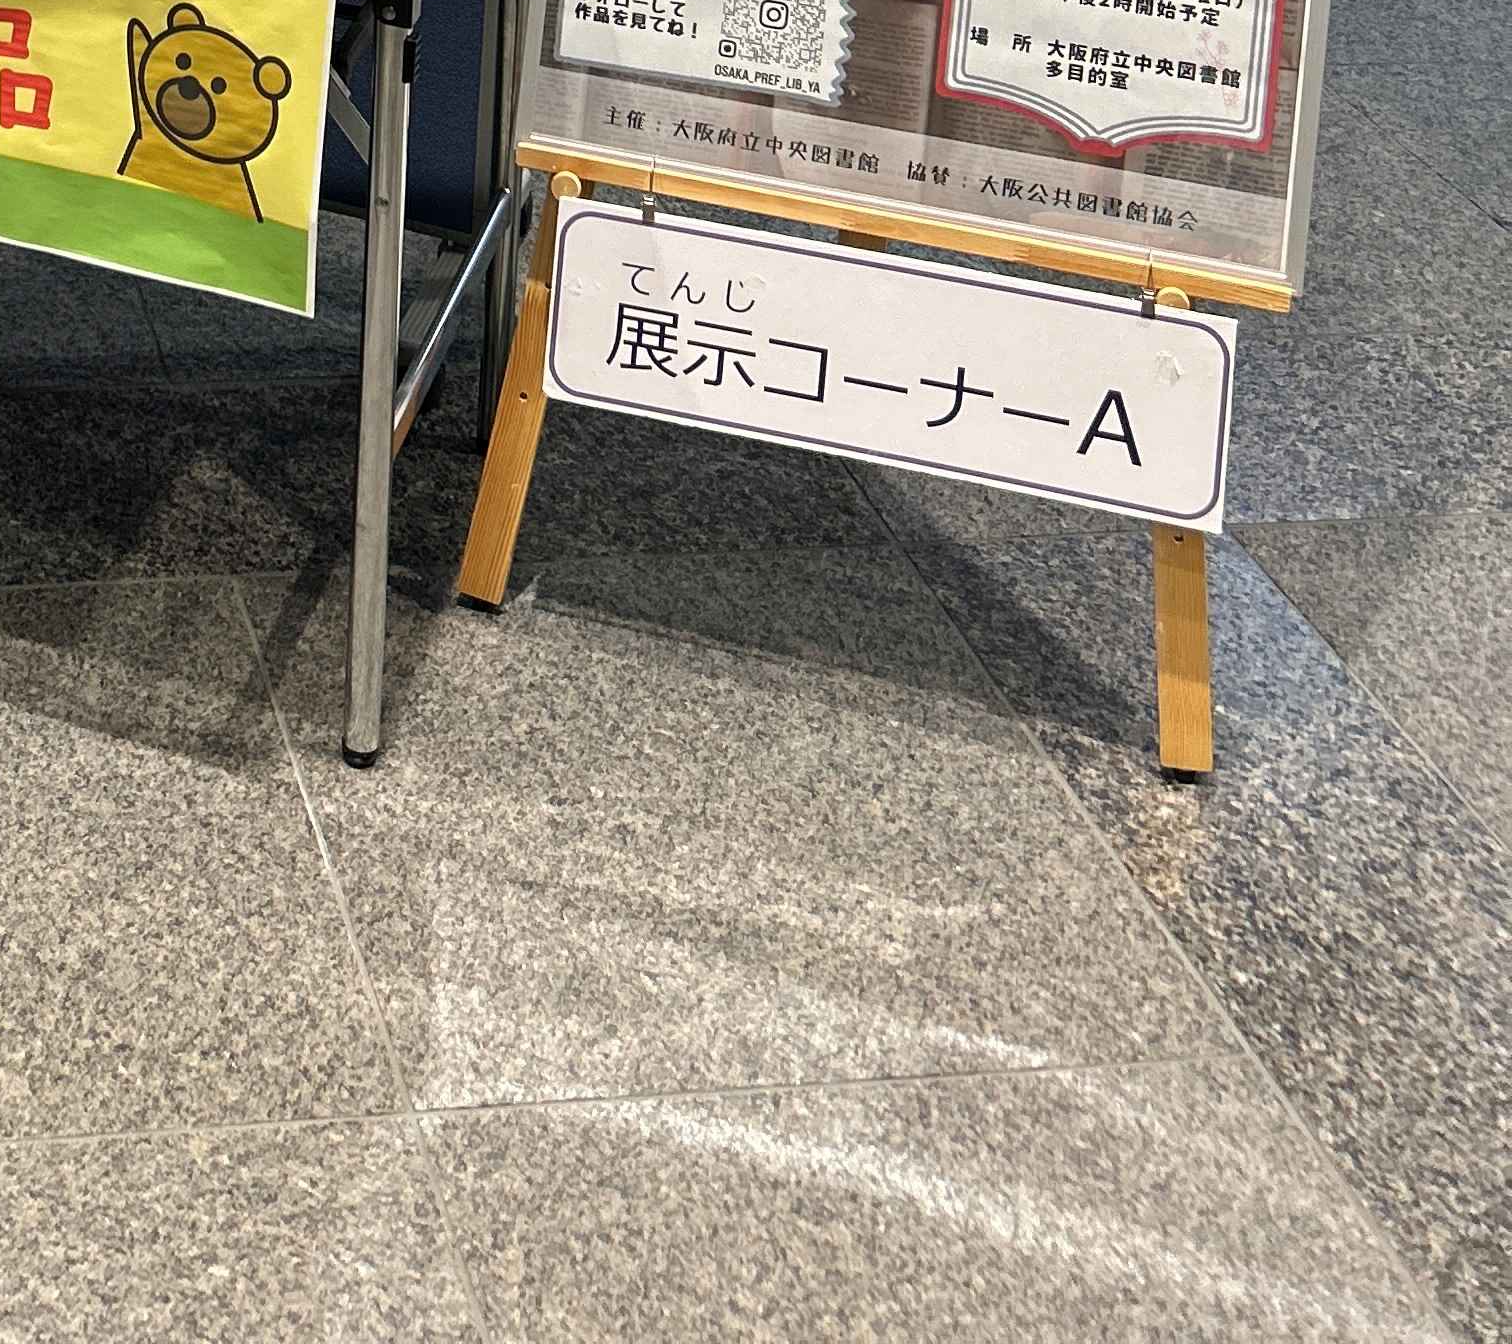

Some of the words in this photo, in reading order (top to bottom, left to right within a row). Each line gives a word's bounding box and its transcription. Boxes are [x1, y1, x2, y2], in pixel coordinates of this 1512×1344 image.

[575, 1, 699, 40] 作品を見てね！
[713, 64, 822, 95] OSAKA_PREF_LIB_YA
[1045, 61, 1131, 91] 多目的室
[1047, 39, 1242, 90] 大阪府立中央図書館
[604, 104, 881, 176] 主催：大阪府立中央図書館
[906, 159, 1201, 233] 協賛：大阪公共図書館協会
[620, 261, 757, 314] てんじ
[605, 301, 1143, 468] 展示コーナーA
